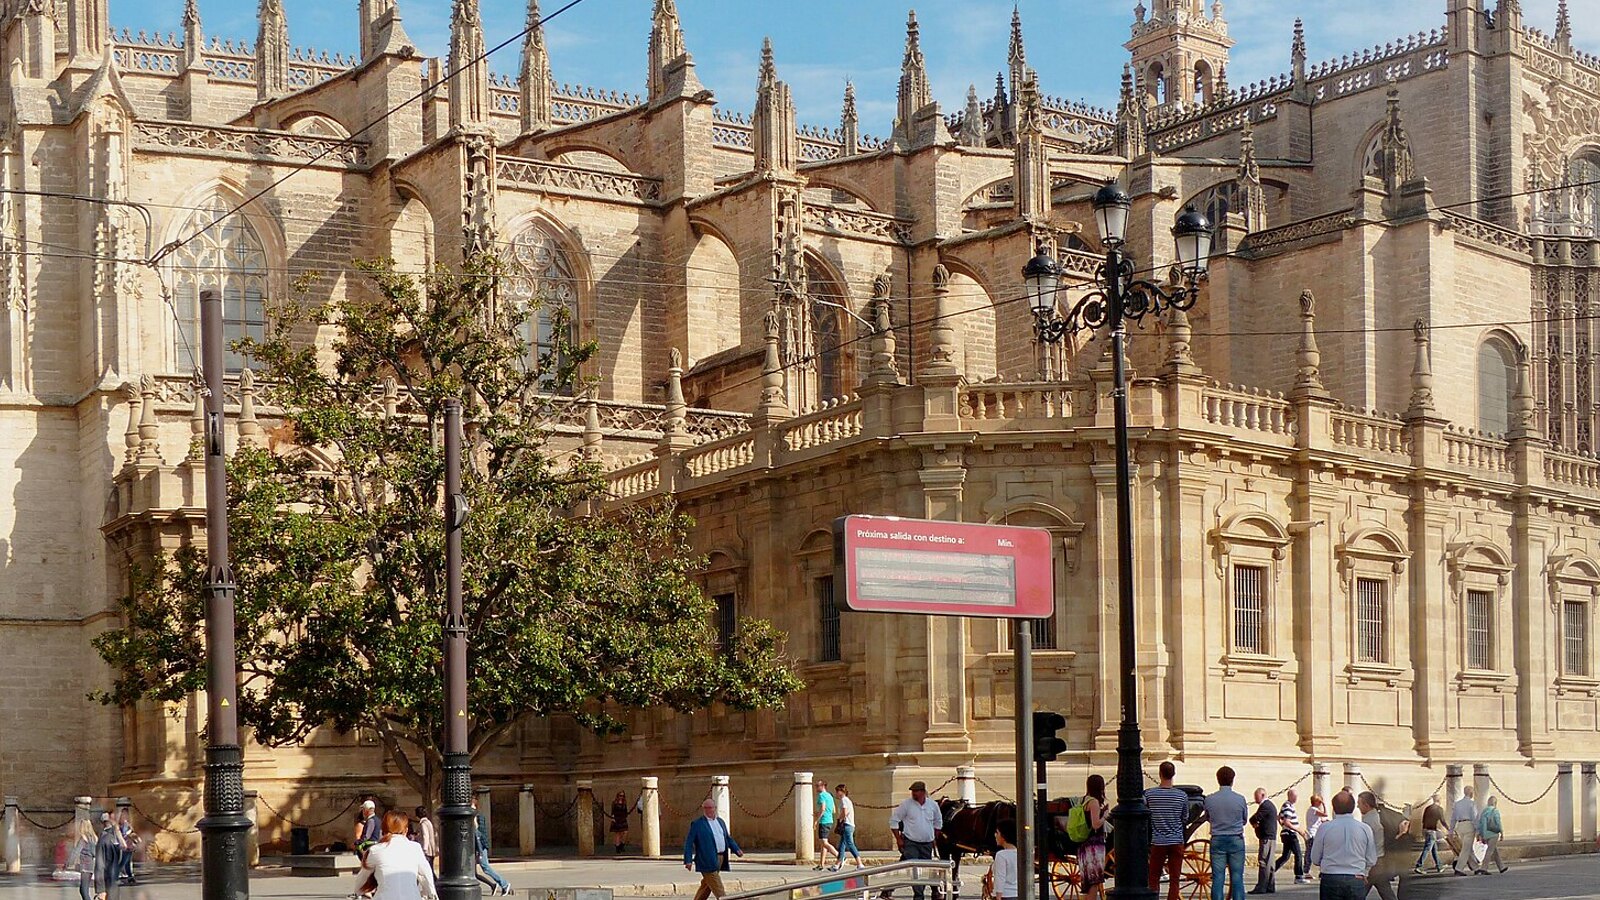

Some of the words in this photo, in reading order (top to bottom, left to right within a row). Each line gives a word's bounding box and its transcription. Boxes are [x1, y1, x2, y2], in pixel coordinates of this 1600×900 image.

[856, 529, 888, 539] Próxima
[890, 531, 912, 541] salida
[913, 534, 928, 542] con
[929, 533, 957, 544] destino
[958, 537, 965, 545] a:
[997, 538, 1015, 548] Min.
